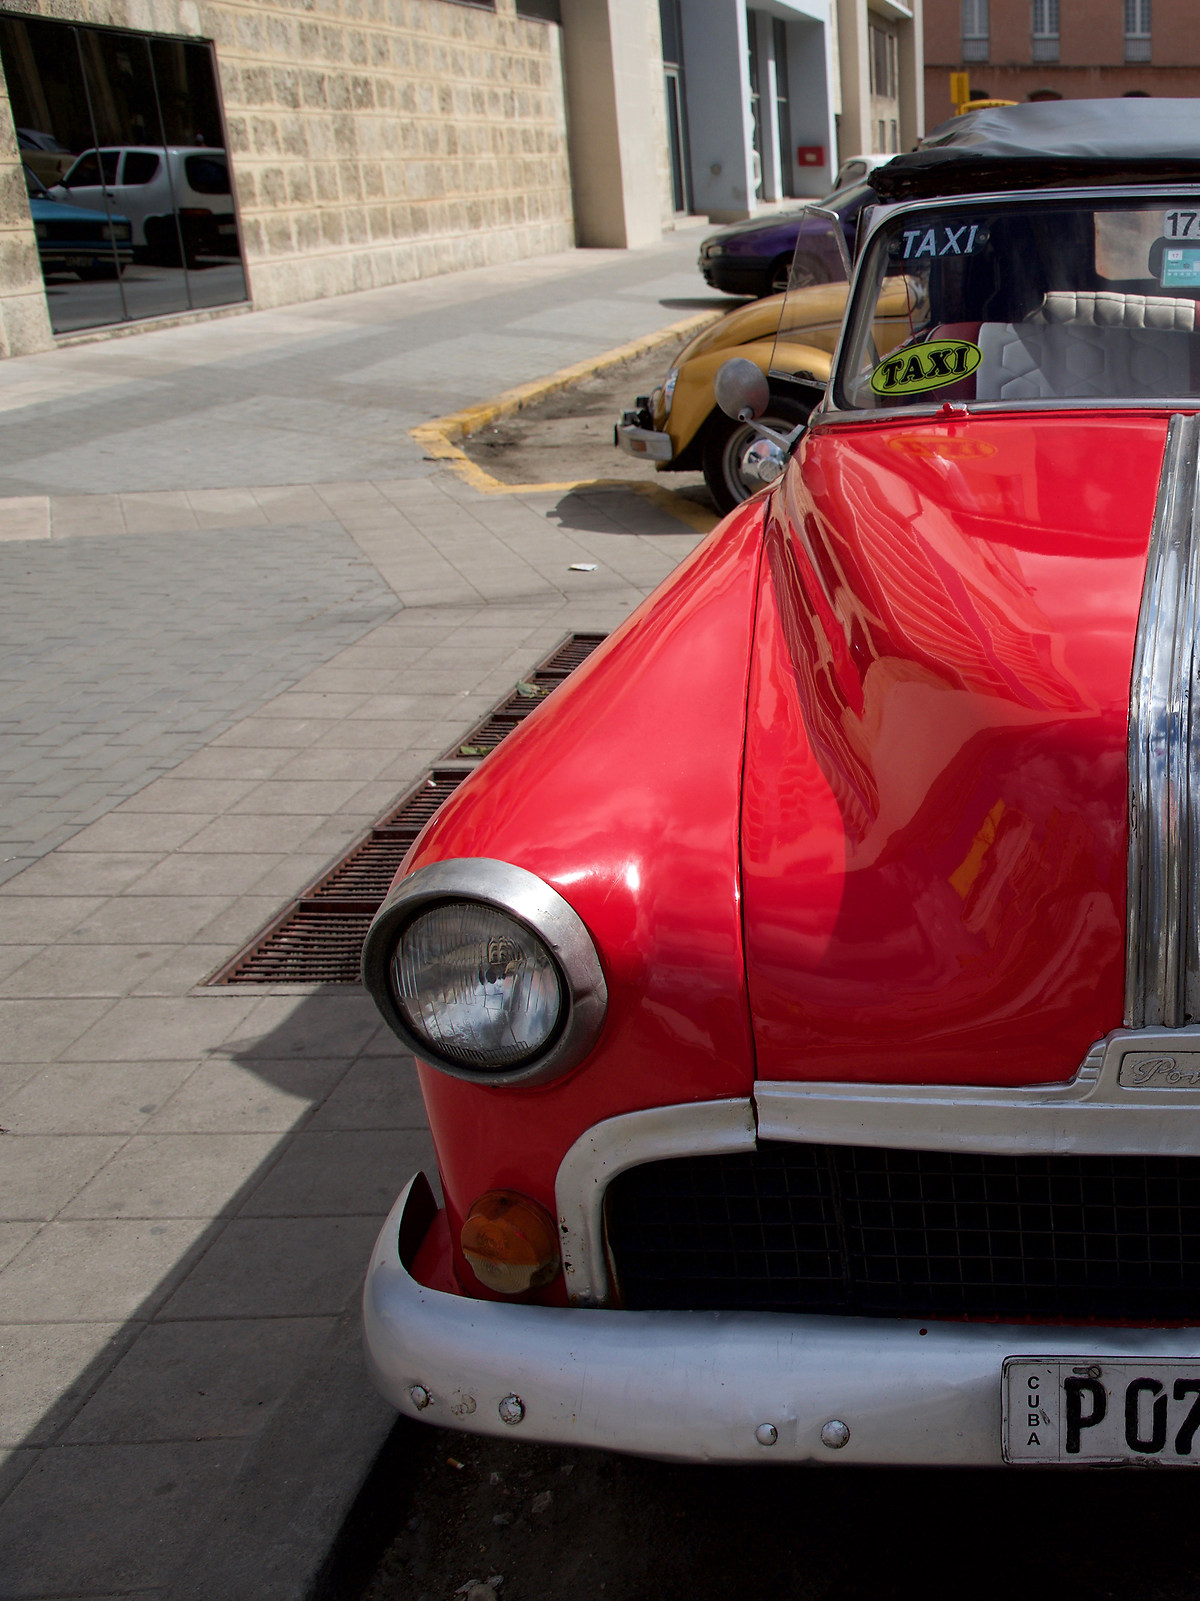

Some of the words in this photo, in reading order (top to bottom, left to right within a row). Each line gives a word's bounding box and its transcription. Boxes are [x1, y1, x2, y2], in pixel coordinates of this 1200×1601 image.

[902, 224, 979, 259] TAXI
[1167, 212, 1197, 237] 17
[881, 346, 968, 390] TAXI
[1027, 1376, 1041, 1446] CUBA
[1064, 1377, 1107, 1454] P
